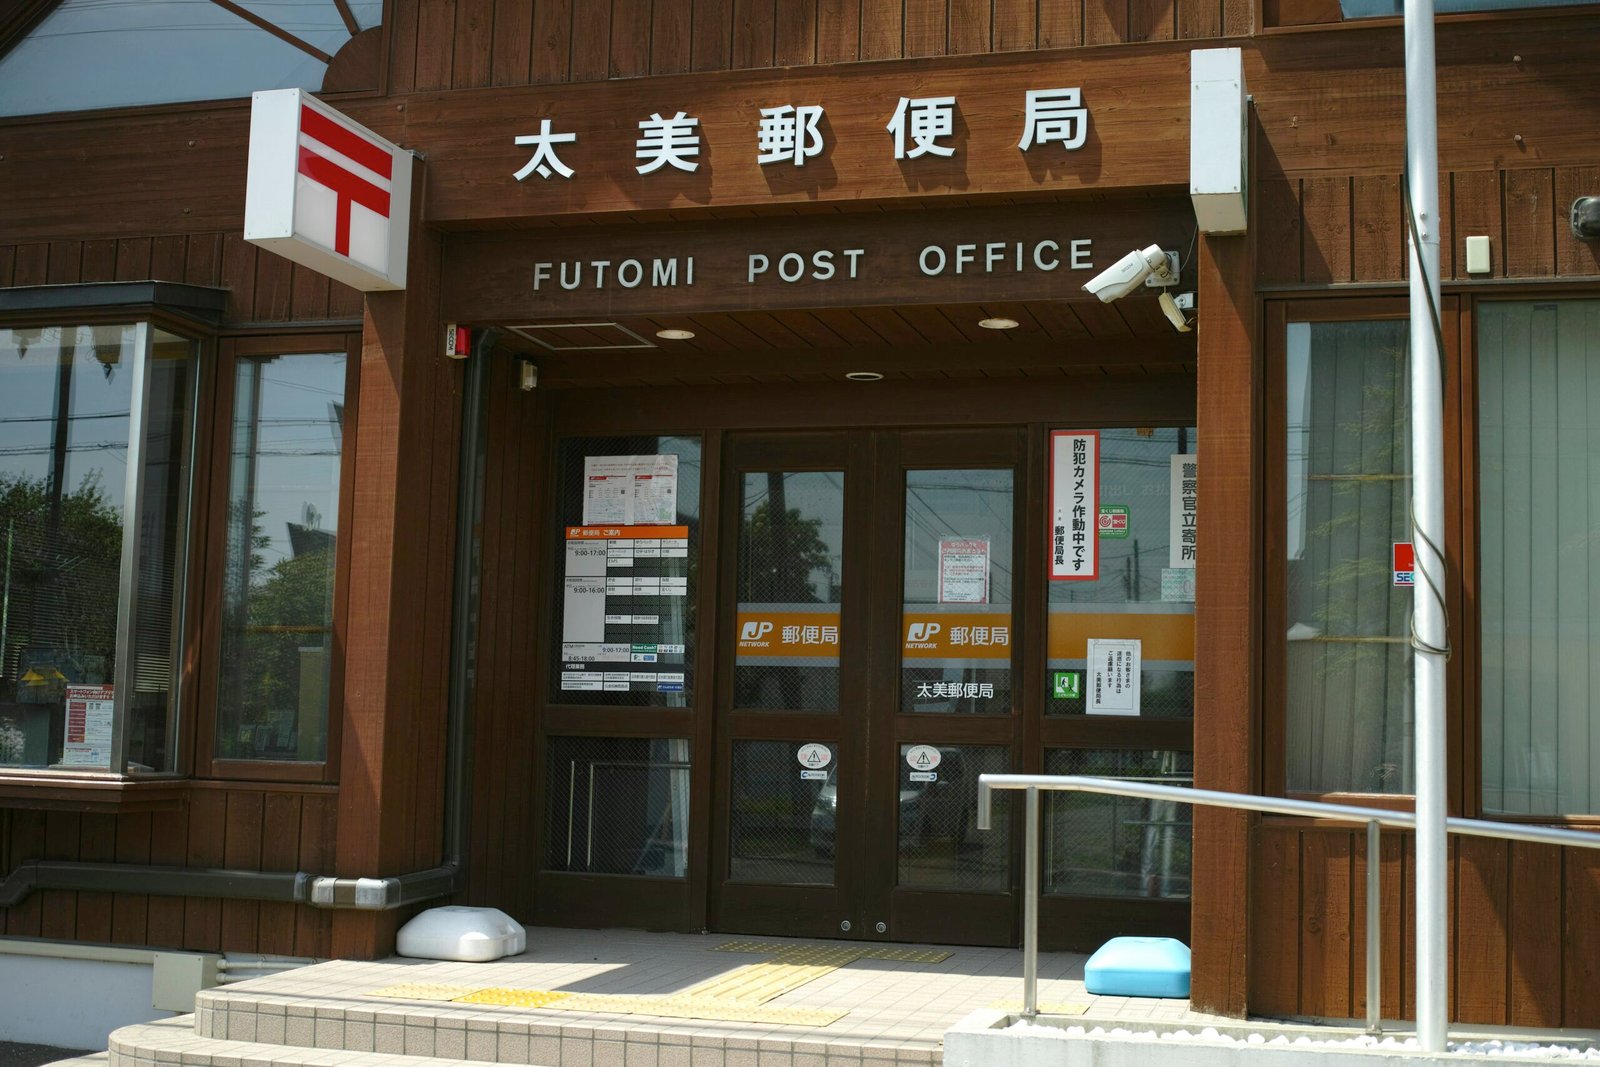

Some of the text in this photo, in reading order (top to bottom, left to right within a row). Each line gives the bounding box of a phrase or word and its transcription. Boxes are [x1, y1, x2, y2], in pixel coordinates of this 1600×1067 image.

[512, 87, 1088, 181] 太美郵便局
[533, 239, 1094, 291] FUTOMI POST OFFICE
[1072, 438, 1087, 571] 防犯カメラ作動中です
[1181, 462, 1197, 560] 警察官立寄所
[603, 529, 621, 537] ご案内
[782, 625, 838, 645] 郵便局
[950, 626, 1009, 646] 郵便局
[917, 682, 994, 699] 太美郵便局
